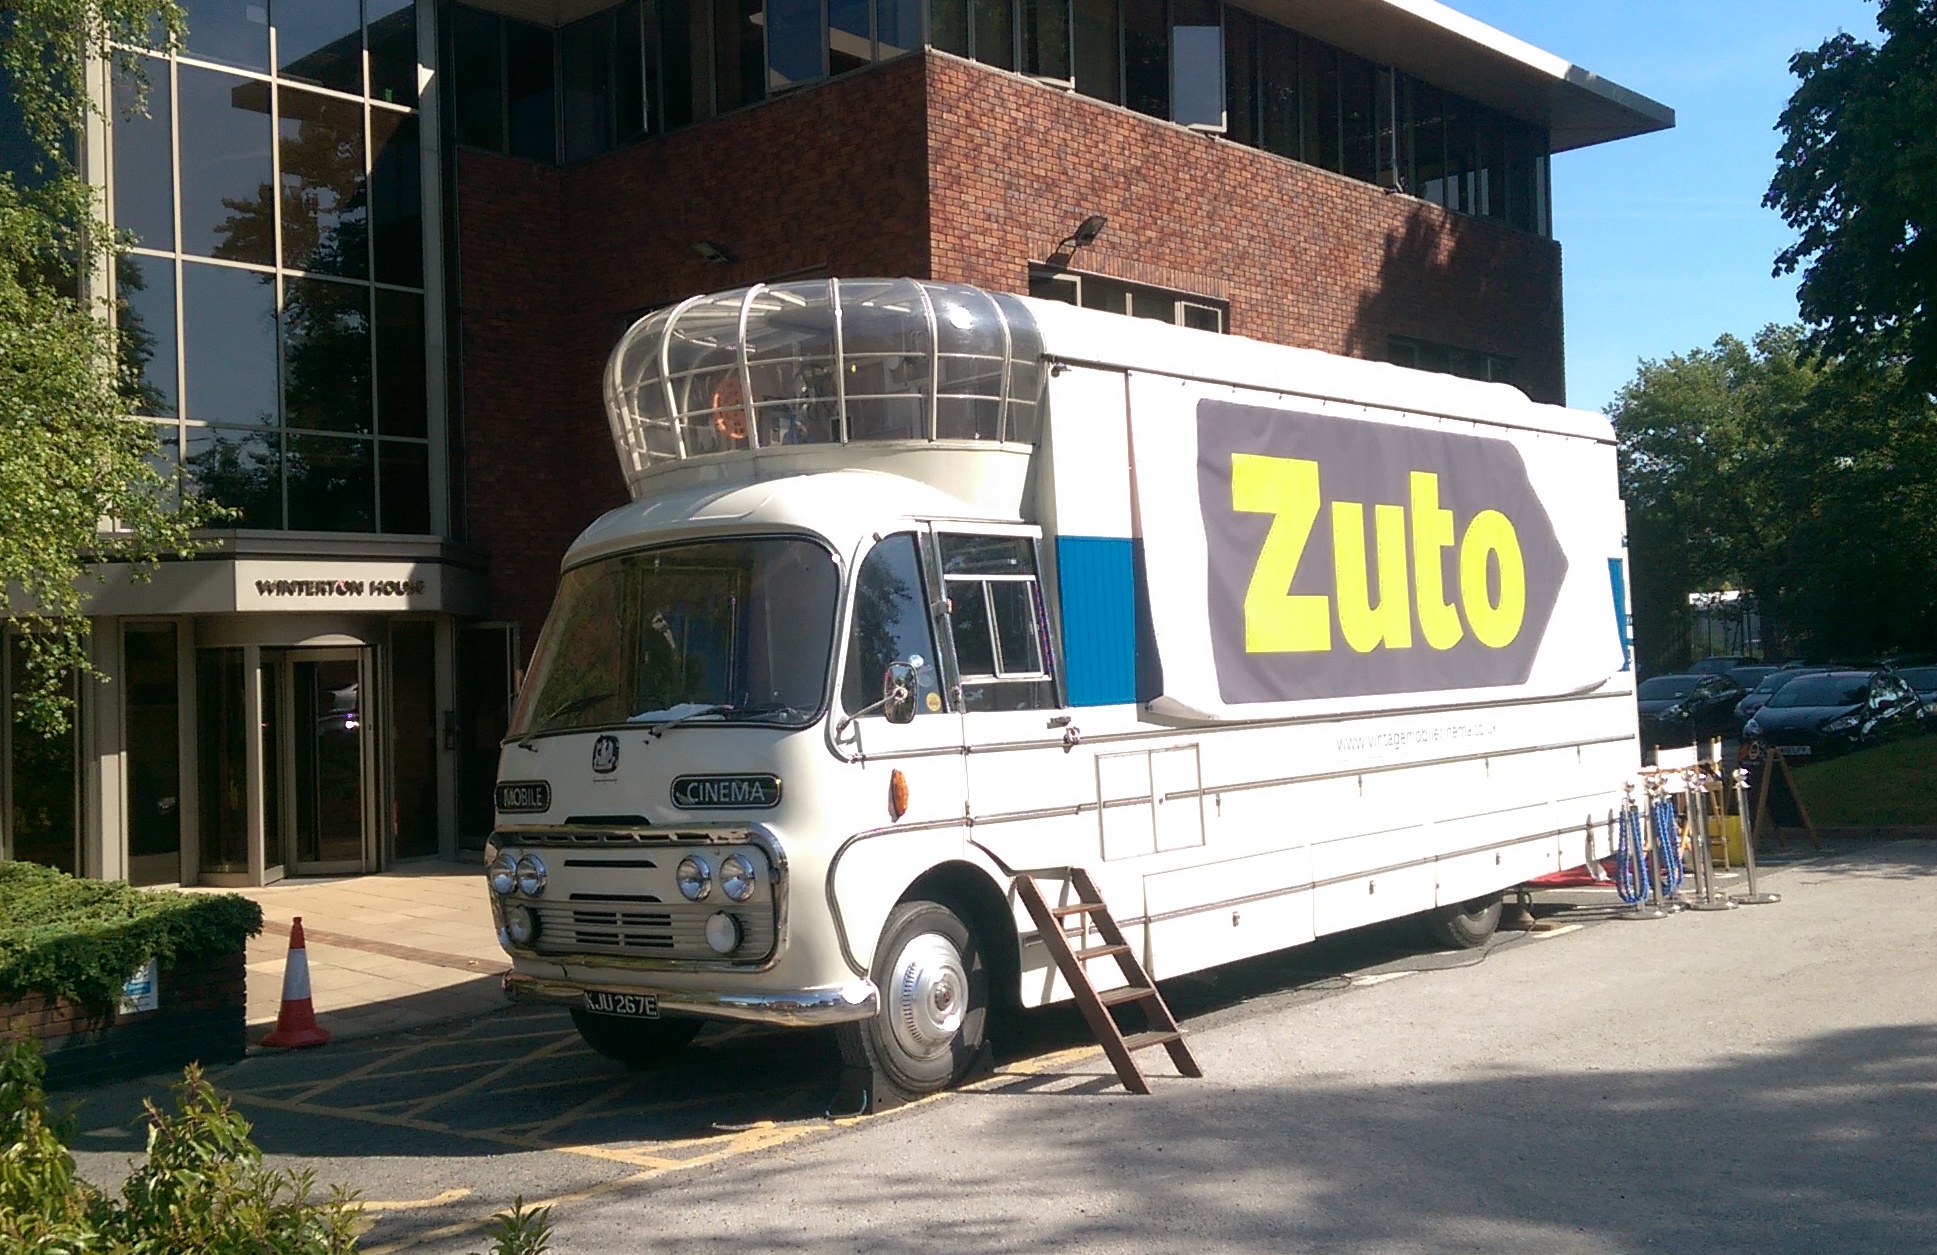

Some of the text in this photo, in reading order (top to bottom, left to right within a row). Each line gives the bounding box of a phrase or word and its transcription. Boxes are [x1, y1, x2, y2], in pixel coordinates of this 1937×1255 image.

[1231, 452, 1526, 653] Zuto
[255, 580, 426, 597] WINTERTON HOUSE
[1336, 723, 1497, 751] wwwvintagemobilecinema.couk
[503, 785, 543, 808] MOBILE
[687, 779, 765, 803] CINEMA
